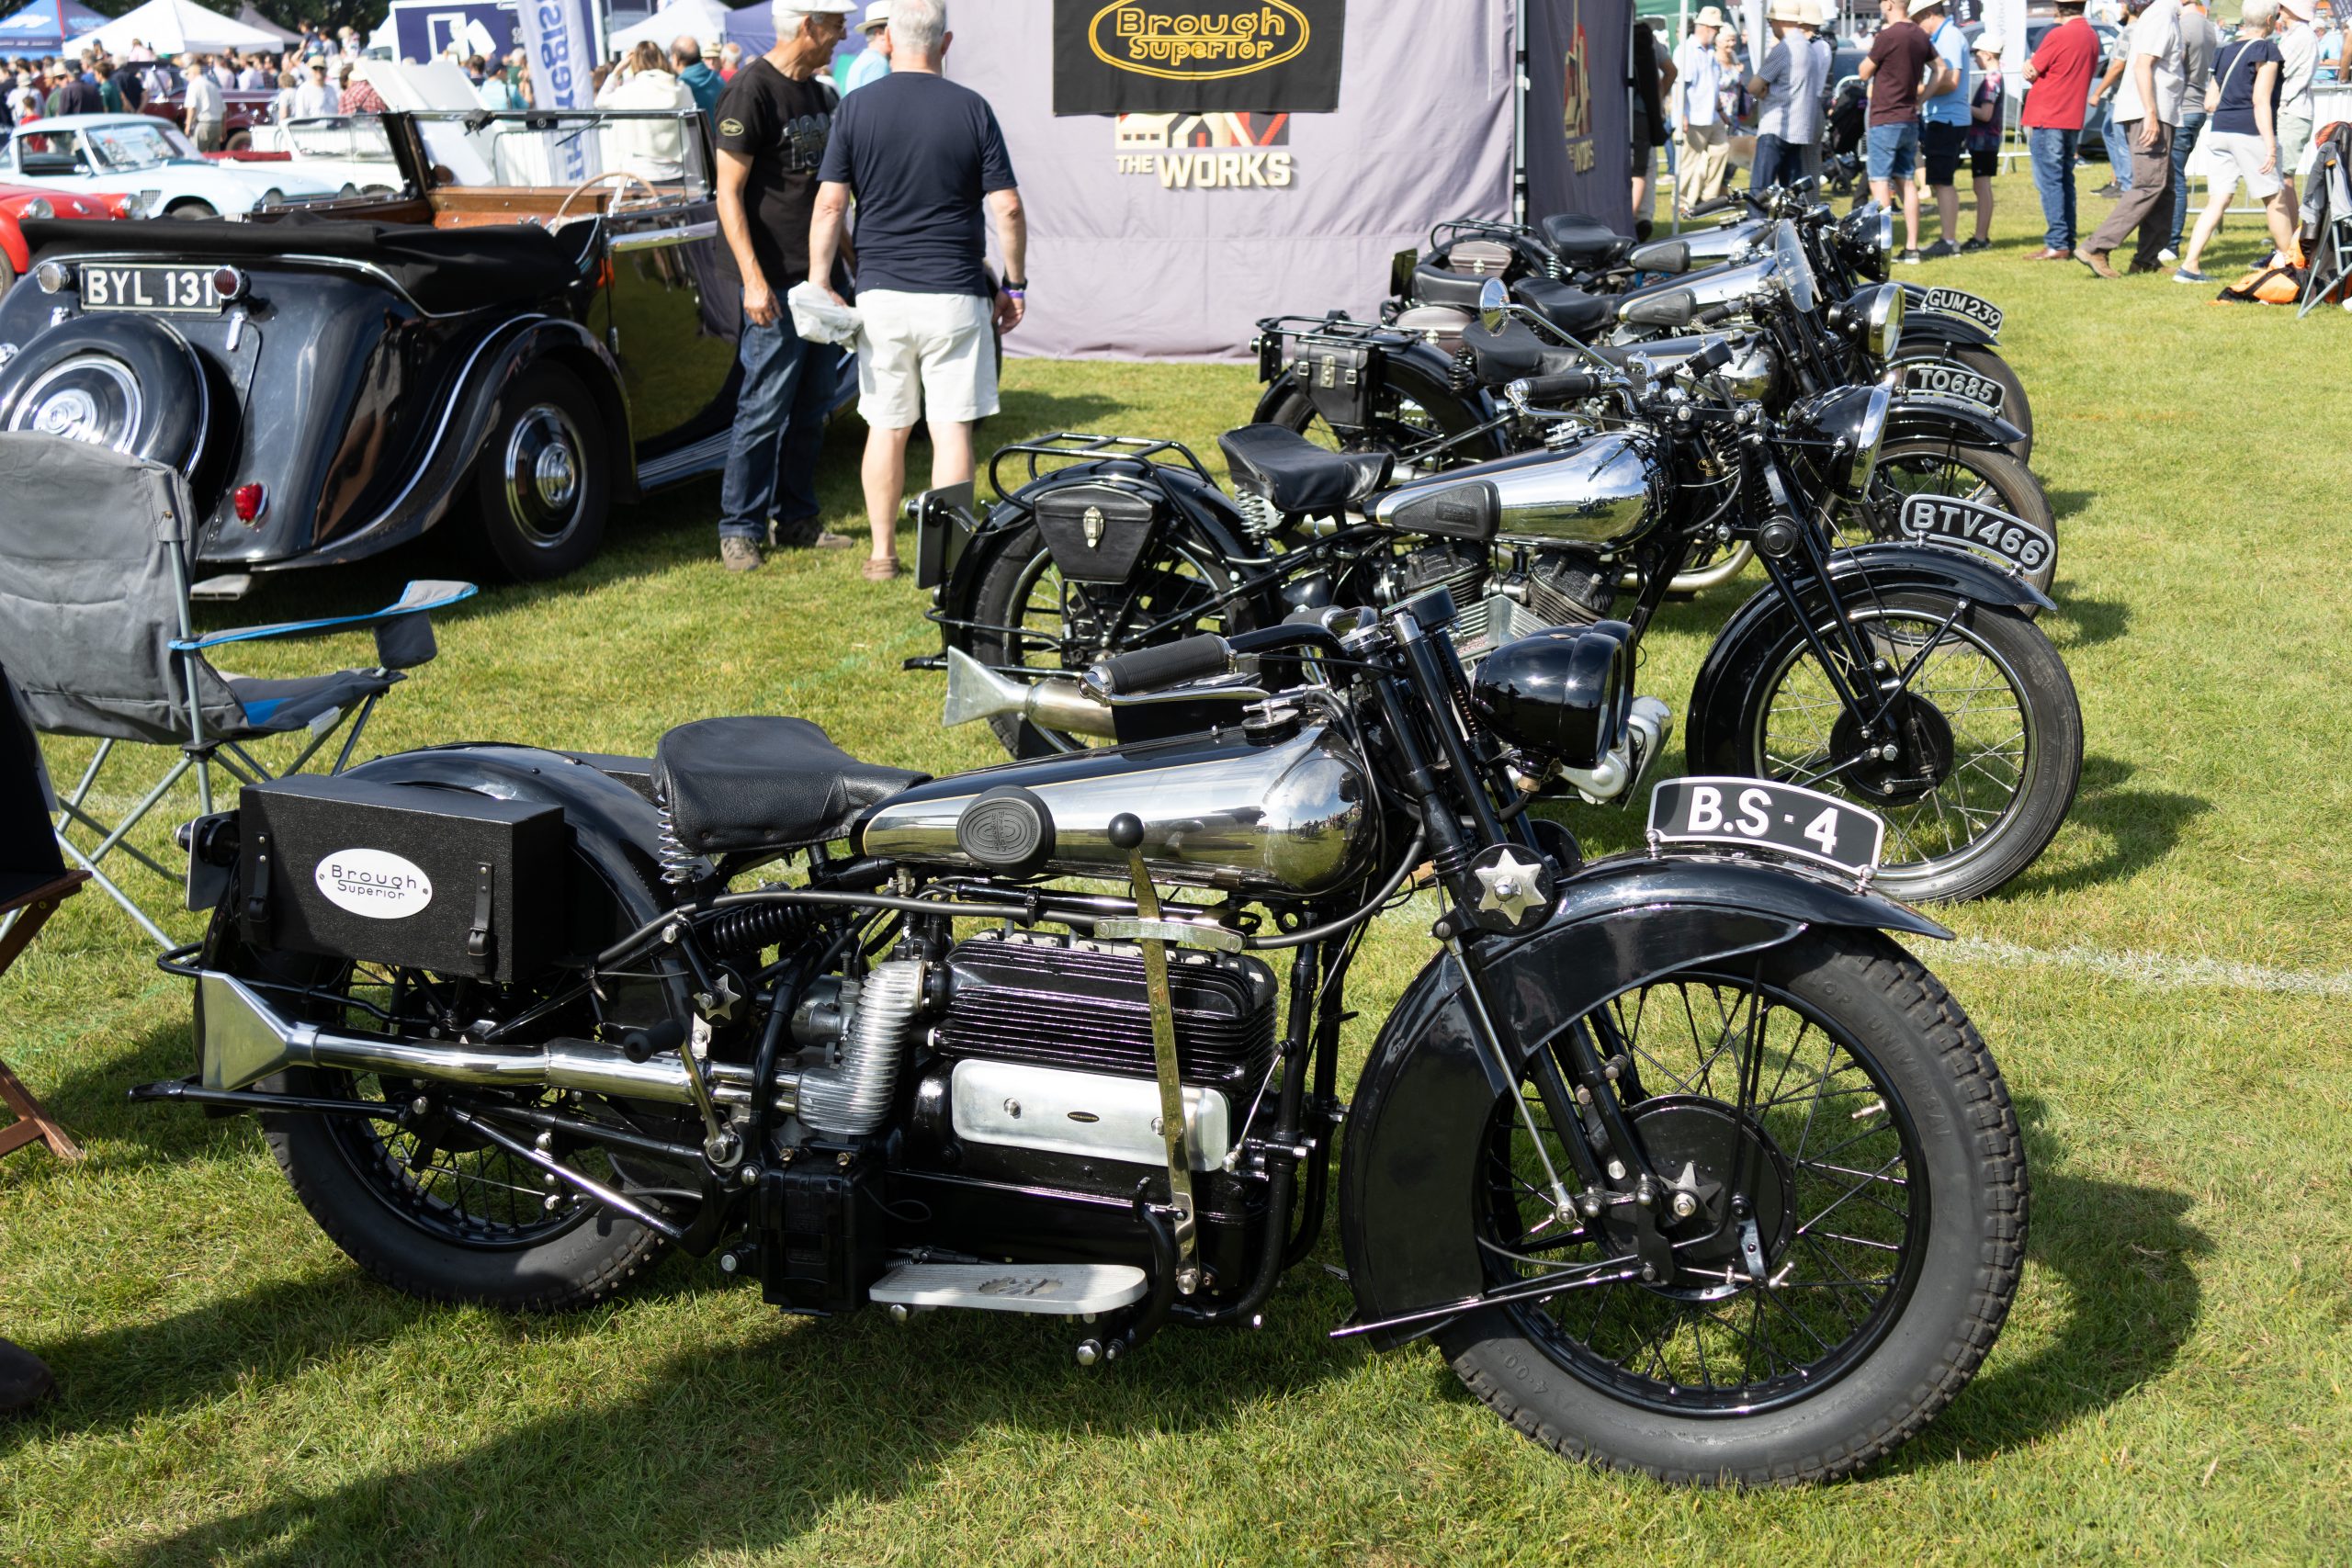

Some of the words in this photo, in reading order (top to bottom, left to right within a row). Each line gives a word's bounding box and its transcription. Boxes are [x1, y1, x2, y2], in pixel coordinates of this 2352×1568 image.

[1116, 7, 1285, 40] Brough
[1129, 36, 1274, 66] Superior
[1115, 154, 1155, 175] THE
[1156, 152, 1292, 188] WORKS
[87, 270, 153, 306] BYL
[165, 271, 213, 307] 131
[1913, 502, 2046, 566] BTV466
[332, 864, 417, 889] Brough
[337, 880, 405, 899] Superior
